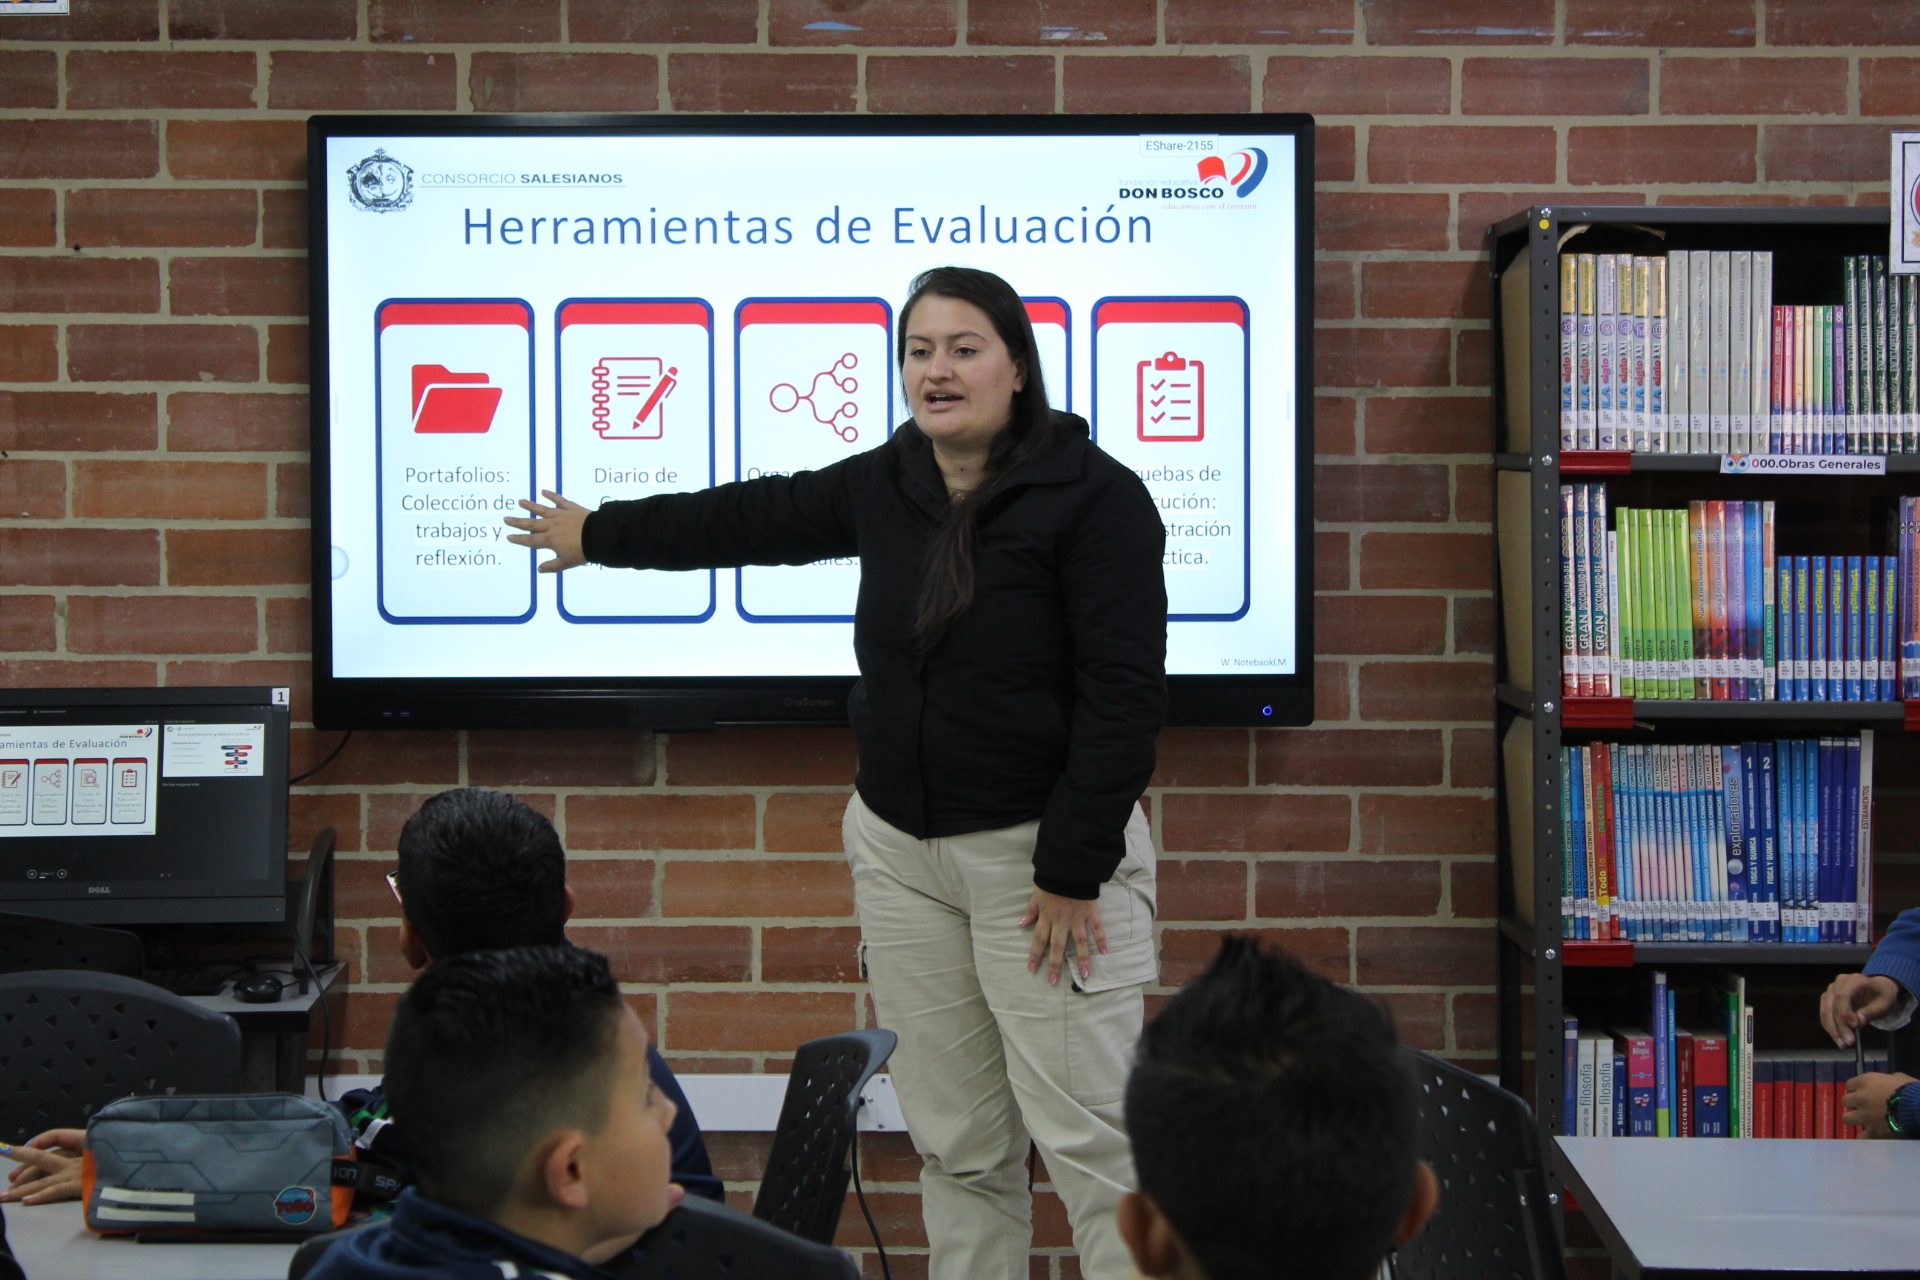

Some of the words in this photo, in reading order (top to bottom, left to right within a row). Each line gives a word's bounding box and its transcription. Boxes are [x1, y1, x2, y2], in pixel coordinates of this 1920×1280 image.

[1146, 140, 1214, 151] EShare-2155
[421, 174, 516, 184] CONSORCIO
[520, 174, 623, 184] SALESIANOS
[1119, 188, 1158, 198] DON
[1162, 188, 1224, 198] BOSCO
[464, 207, 793, 245] Herramientas
[815, 205, 872, 244] de
[894, 204, 1152, 244] Evaluación
[1877, 262, 1883, 271] 3
[1777, 310, 1780, 321] 1
[1836, 312, 1841, 322] 8
[1876, 326, 1886, 370] ENCICLOPEDIA
[1562, 357, 1571, 382] siglo
[1580, 358, 1590, 383] siglo
[1601, 358, 1610, 383] siglo
[1620, 357, 1628, 382] siglo
[1635, 360, 1644, 385] siglo
[1752, 458, 1814, 468] 000.Obras
[1819, 459, 1880, 470] Generales
[405, 466, 511, 484] Portafolios:
[594, 467, 648, 484] Diario
[656, 467, 678, 484] de
[1134, 466, 1194, 482] uebas
[1199, 466, 1221, 482] de
[402, 494, 488, 512] Colección
[494, 494, 516, 512] de
[1152, 493, 1216, 509] cución:
[415, 522, 488, 542] trabajos
[494, 527, 502, 541] y
[1164, 520, 1231, 536] stración
[415, 550, 502, 566] reflexión.
[1162, 549, 1208, 564] ctica.
[1577, 573, 1587, 610] DICCIONARIO
[1594, 575, 1604, 611] DICCIONARIO
[1579, 615, 1589, 649] GRAN
[1595, 616, 1604, 650] GRAN
[278, 692, 284, 702] 1
[52, 740, 66, 748] de
[70, 738, 128, 748] Evaluación
[1747, 757, 1752, 769] 1
[1763, 757, 1770, 769] 2
[1596, 785, 1605, 832] necesitas
[1726, 778, 1743, 856] exploradores
[1598, 858, 1605, 866] lo
[1598, 871, 1607, 895] Todo
[1579, 1064, 1592, 1106] filosofía
[1599, 1063, 1611, 1105] filosofía
